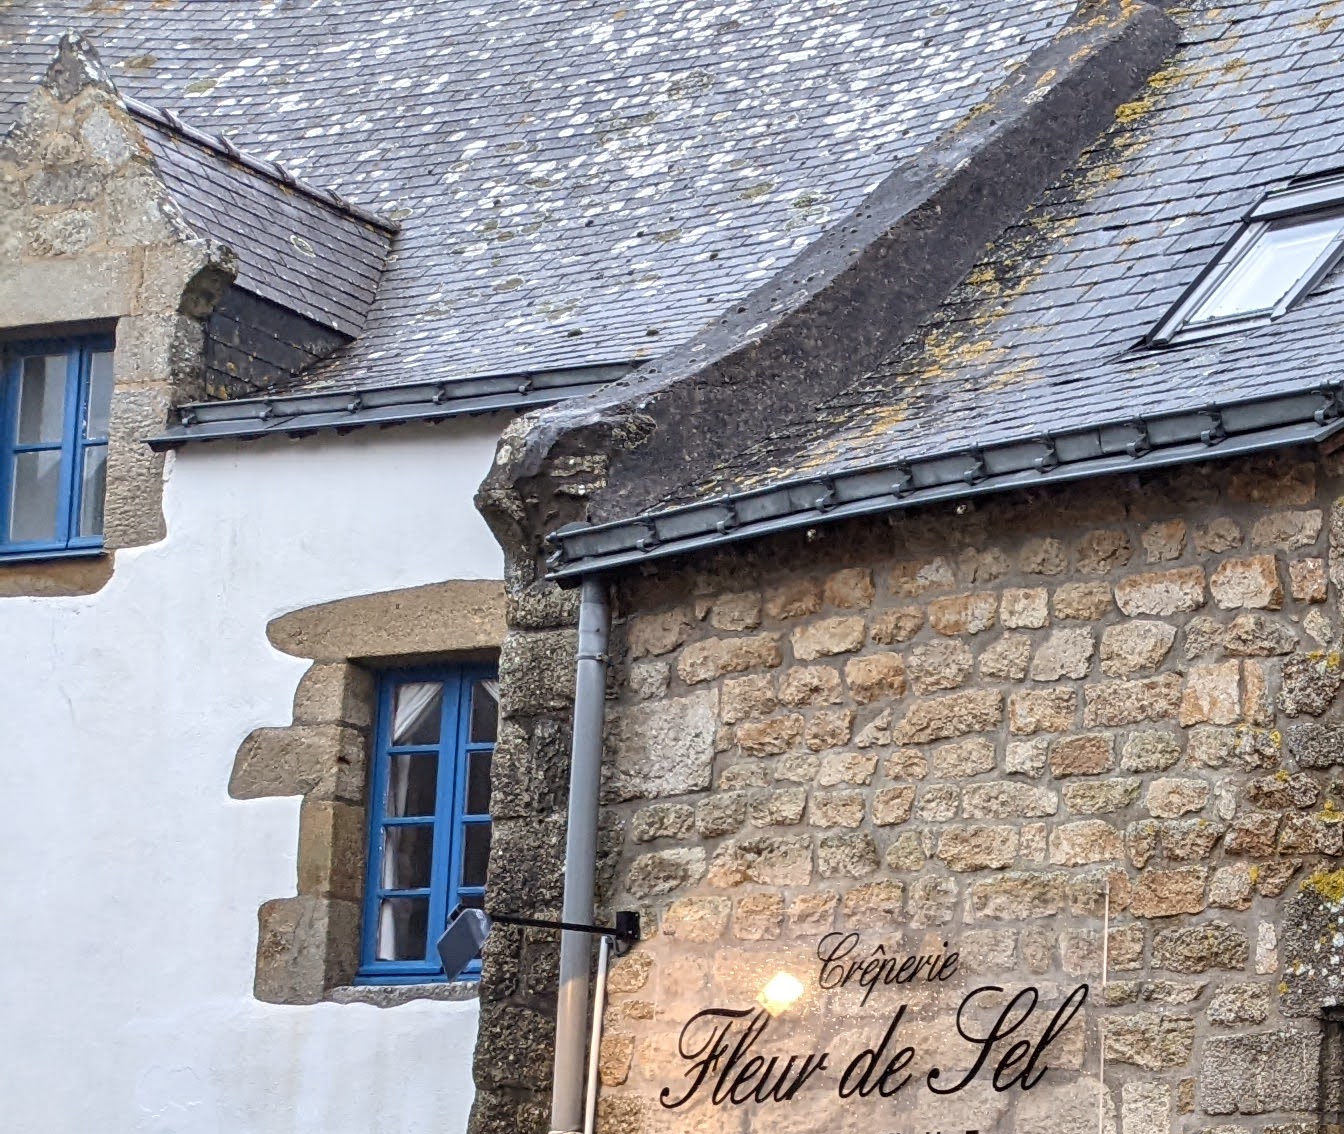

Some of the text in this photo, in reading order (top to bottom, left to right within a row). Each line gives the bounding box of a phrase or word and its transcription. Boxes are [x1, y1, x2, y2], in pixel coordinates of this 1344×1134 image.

[817, 931, 960, 1007] Crêperie
[659, 983, 1090, 1109] Fleur de Sel
